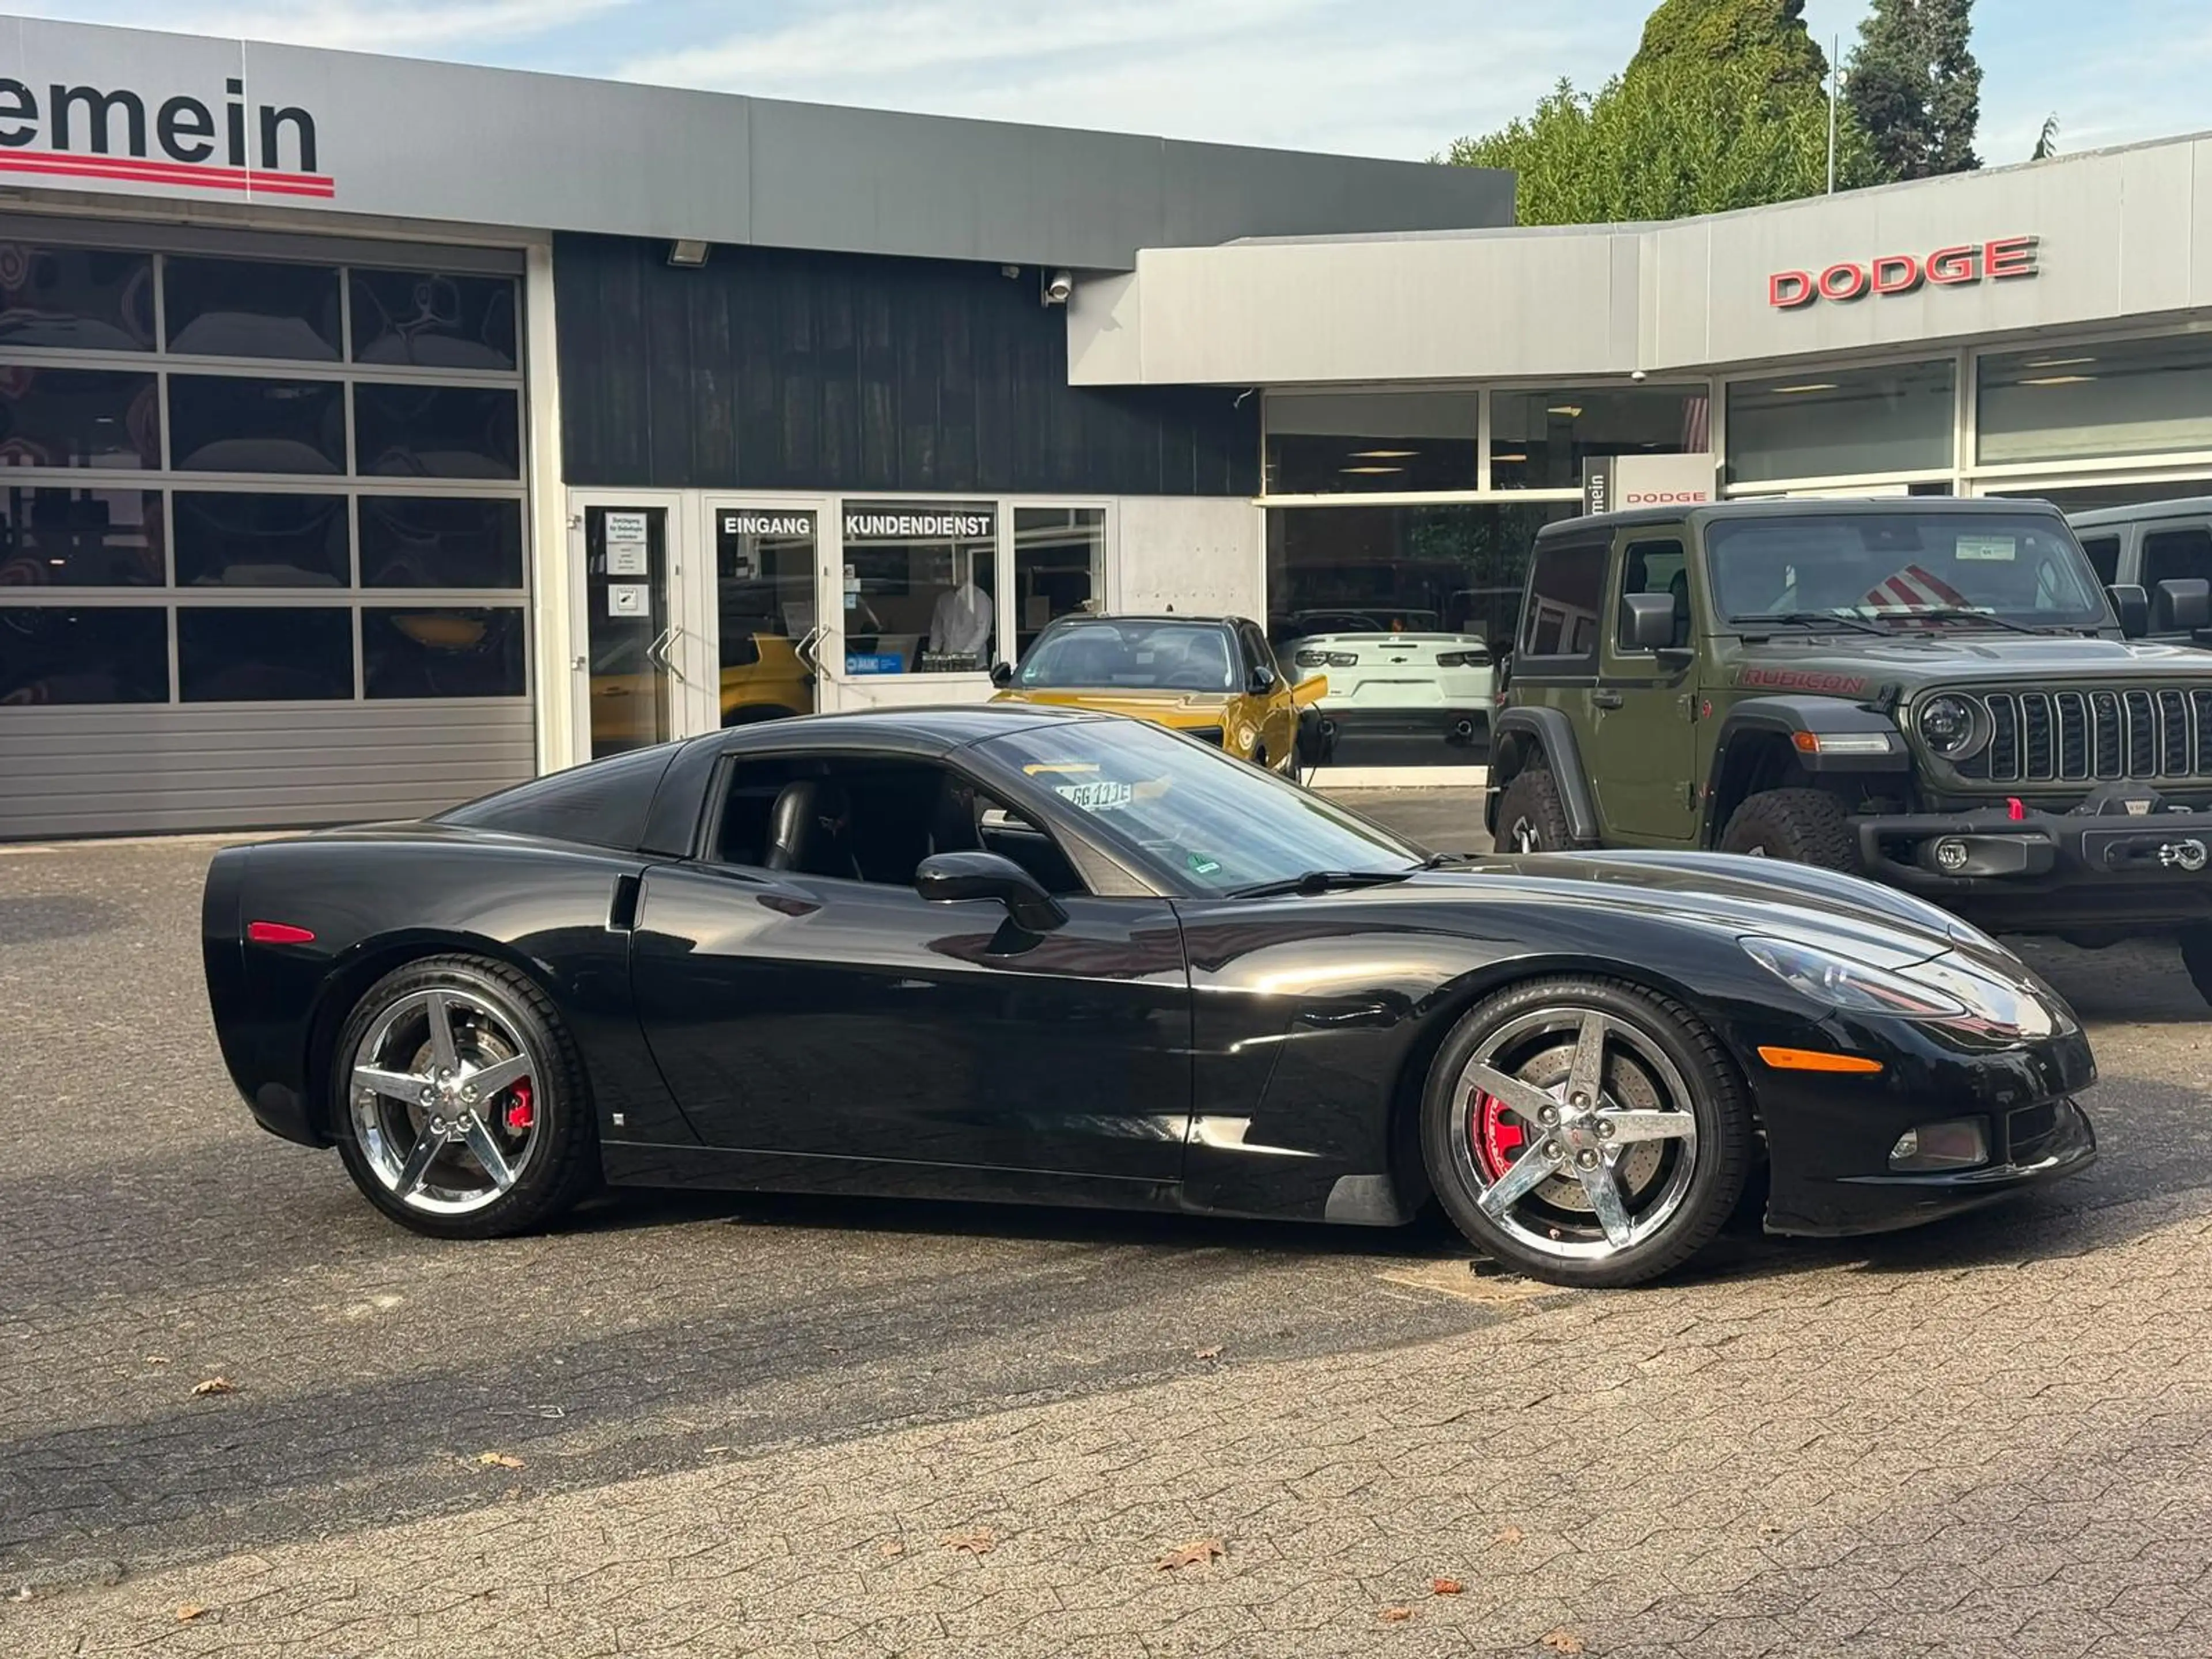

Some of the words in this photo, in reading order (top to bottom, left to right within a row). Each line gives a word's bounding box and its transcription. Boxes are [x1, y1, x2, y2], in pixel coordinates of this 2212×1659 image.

[0, 78, 317, 173] emein
[1768, 234, 2039, 308] DODGE
[1588, 475, 1604, 514] mein
[1627, 491, 1707, 503] DODGE
[724, 517, 810, 534] EINGANG
[846, 515, 990, 535] KUNDENDIENST
[1743, 668, 1866, 692] RUBICON
